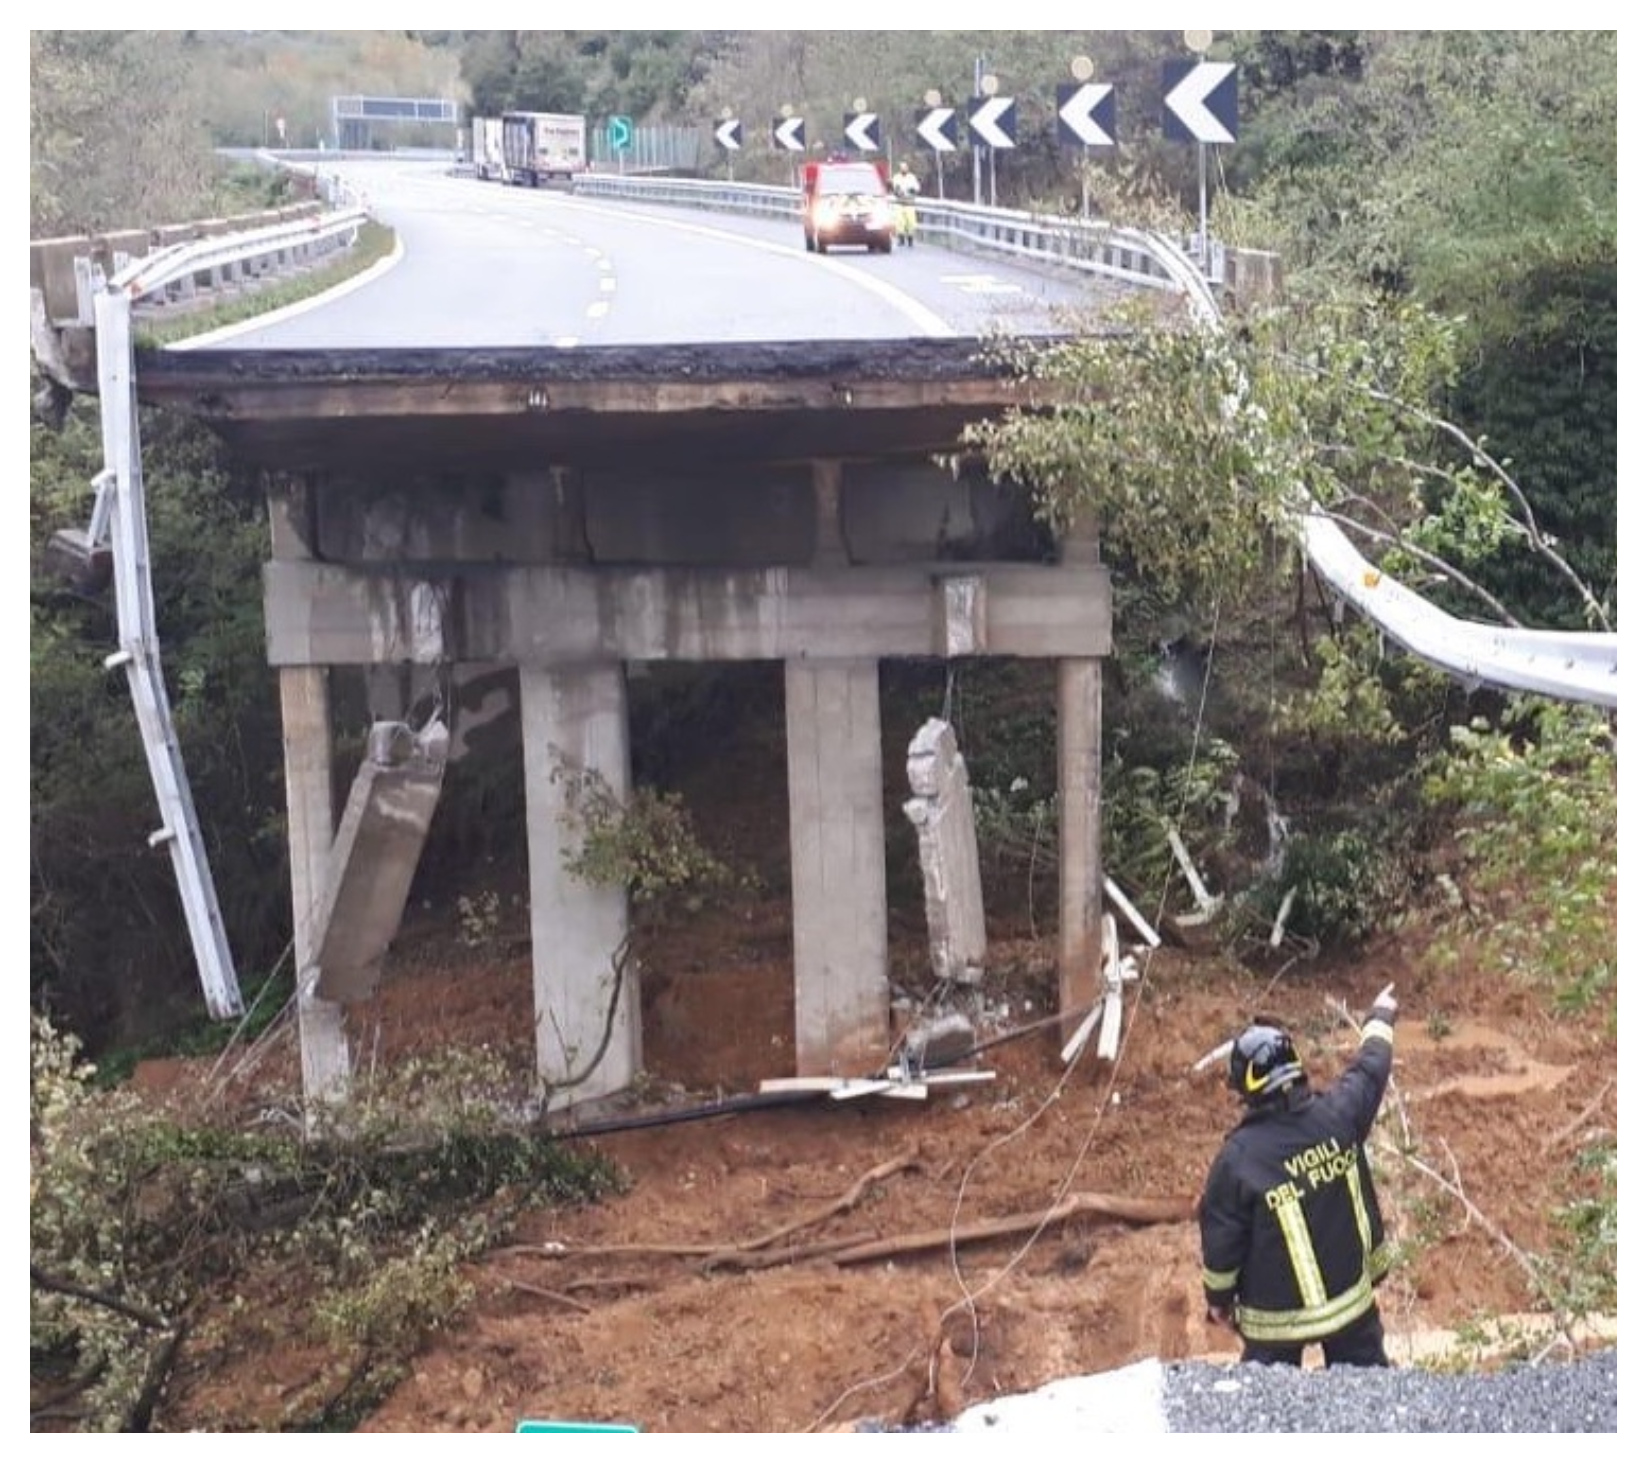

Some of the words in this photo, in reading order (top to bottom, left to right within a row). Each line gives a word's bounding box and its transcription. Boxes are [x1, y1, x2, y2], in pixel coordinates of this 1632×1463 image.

[1265, 1180, 1305, 1211] DEL
[1307, 1143, 1357, 1190] FUOC
[1284, 1136, 1340, 1177] VIGILI
